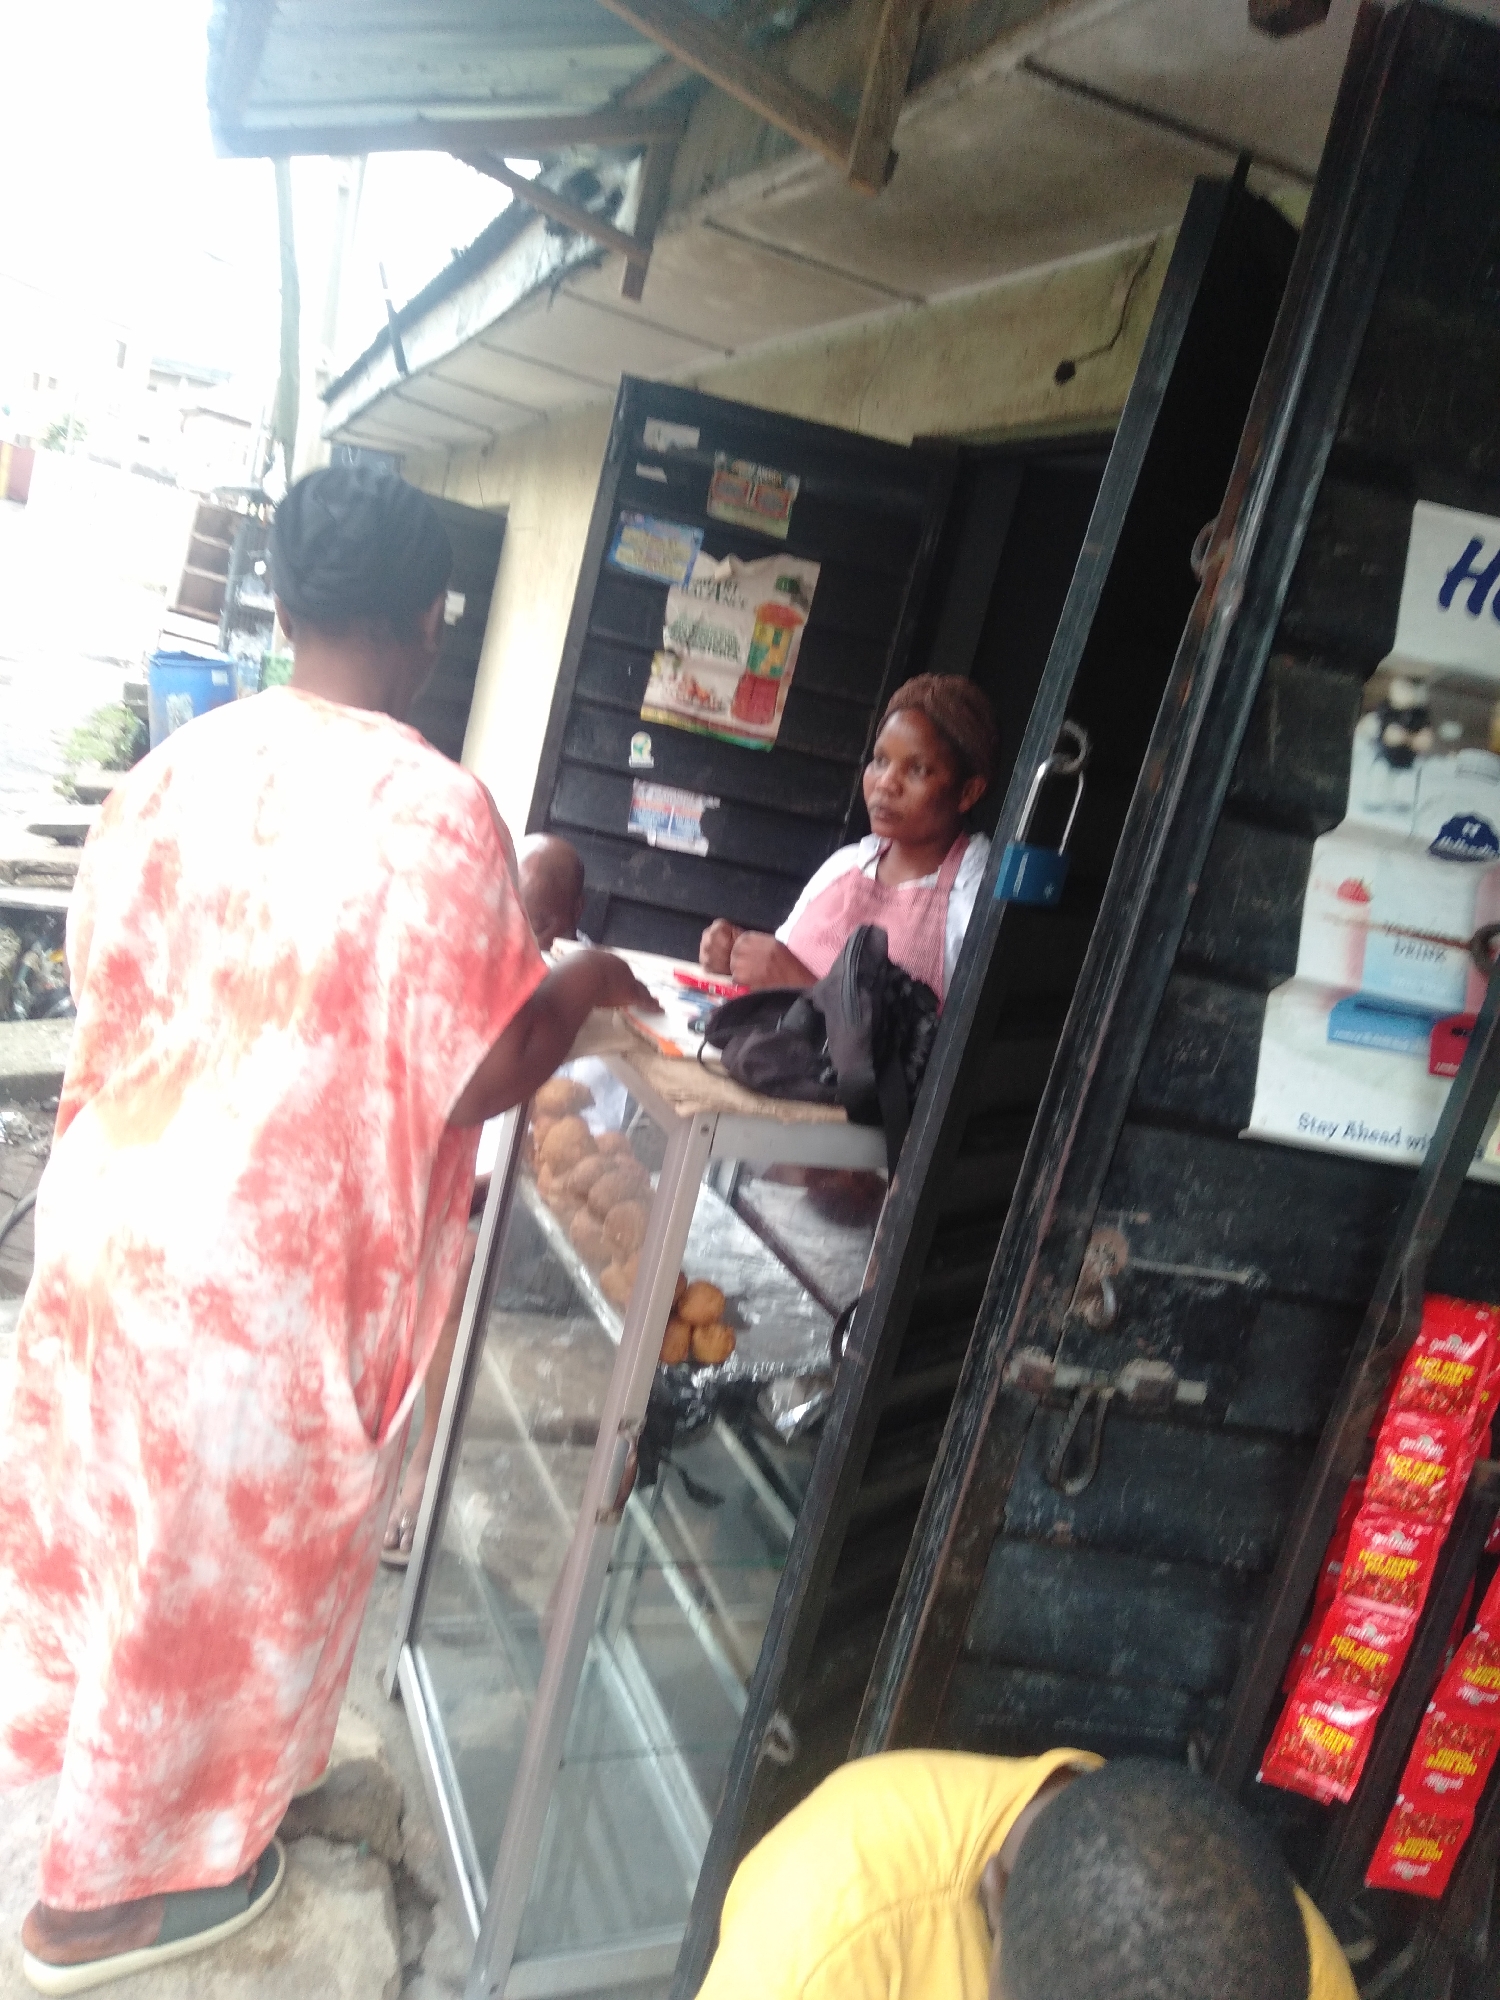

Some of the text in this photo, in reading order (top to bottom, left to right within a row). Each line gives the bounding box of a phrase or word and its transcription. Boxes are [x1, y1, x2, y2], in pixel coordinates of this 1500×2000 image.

[1438, 534, 1500, 623] H
[1298, 1111, 1340, 1141] Stay
[1342, 1119, 1403, 1149] Ahead
